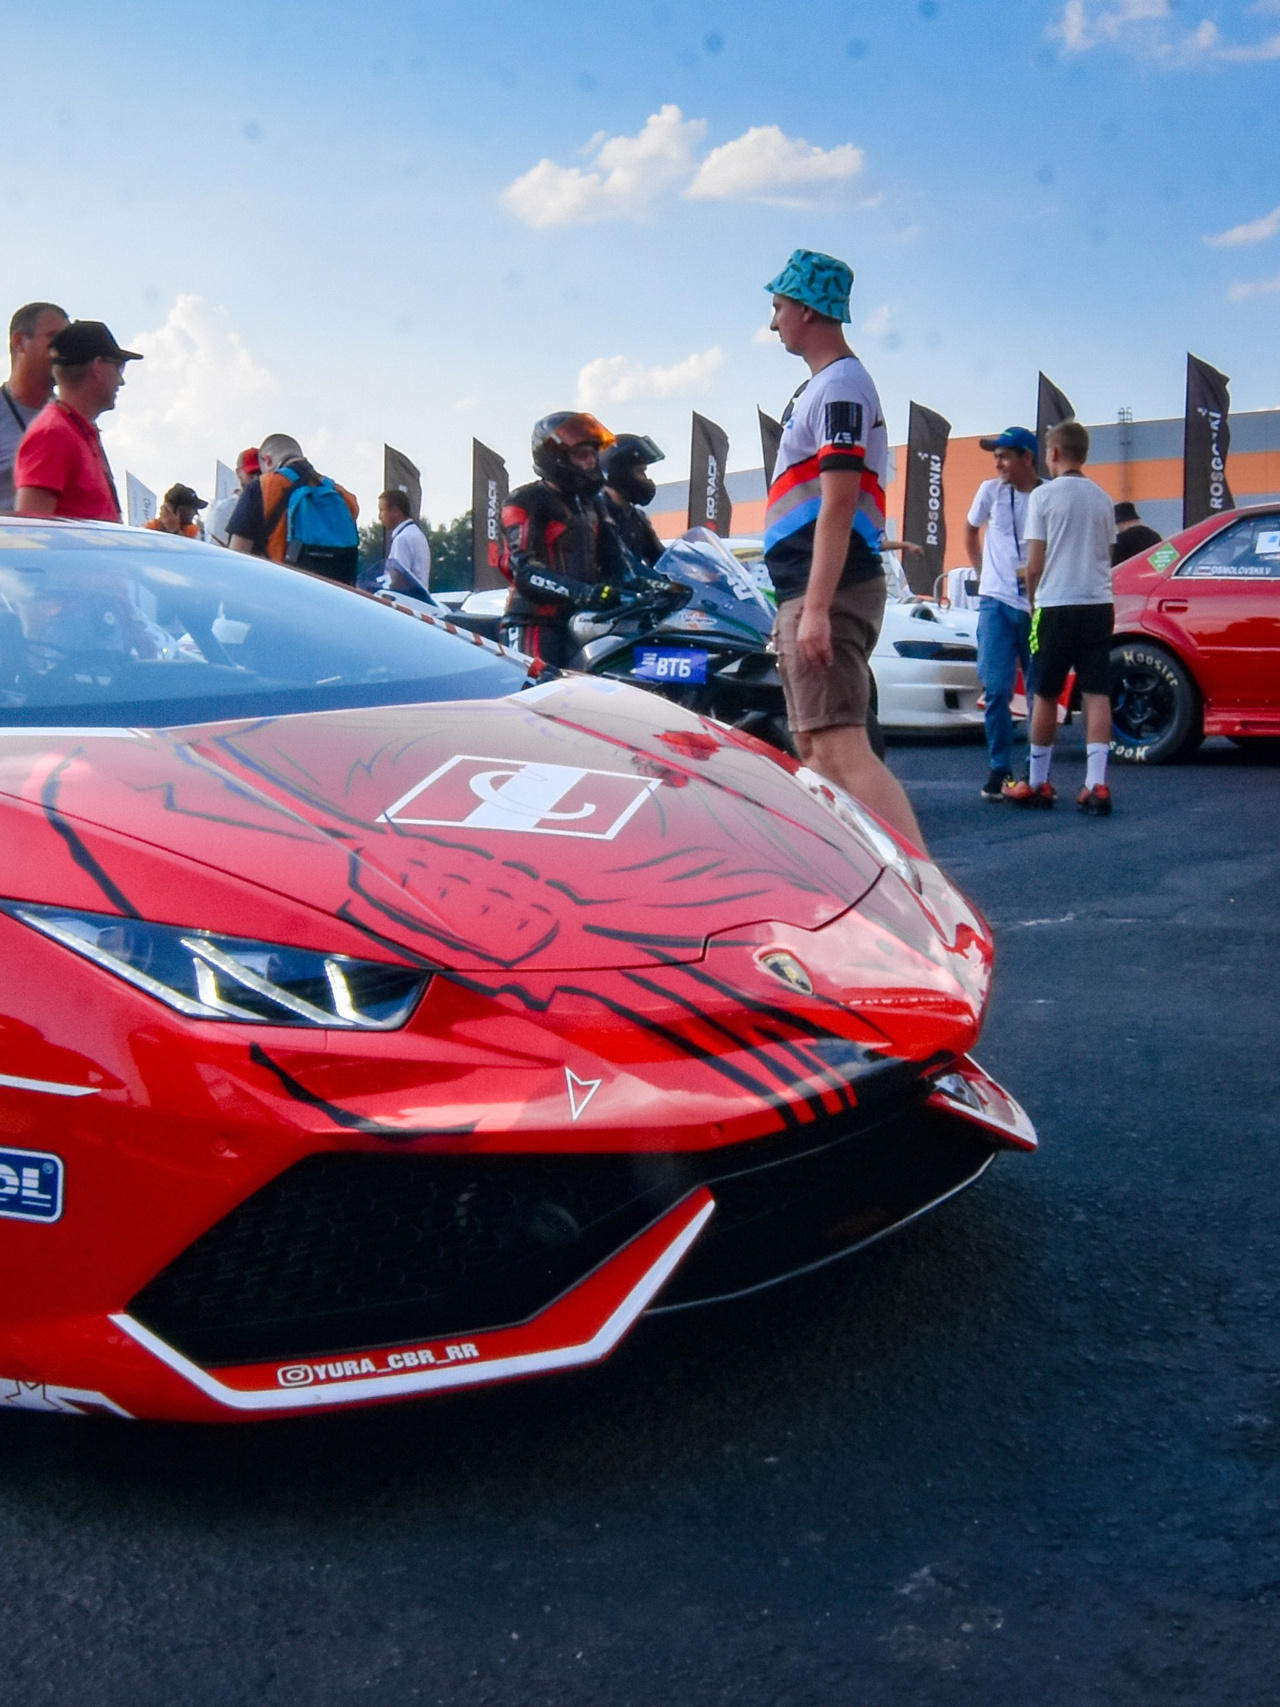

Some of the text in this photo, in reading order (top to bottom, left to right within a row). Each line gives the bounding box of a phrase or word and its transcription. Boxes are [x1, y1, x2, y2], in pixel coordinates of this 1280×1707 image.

[926, 454, 942, 546] ROSGONKI
[656, 657, 692, 678] ВТБ
[312, 1342, 480, 1380] YURA_CBR_RR
